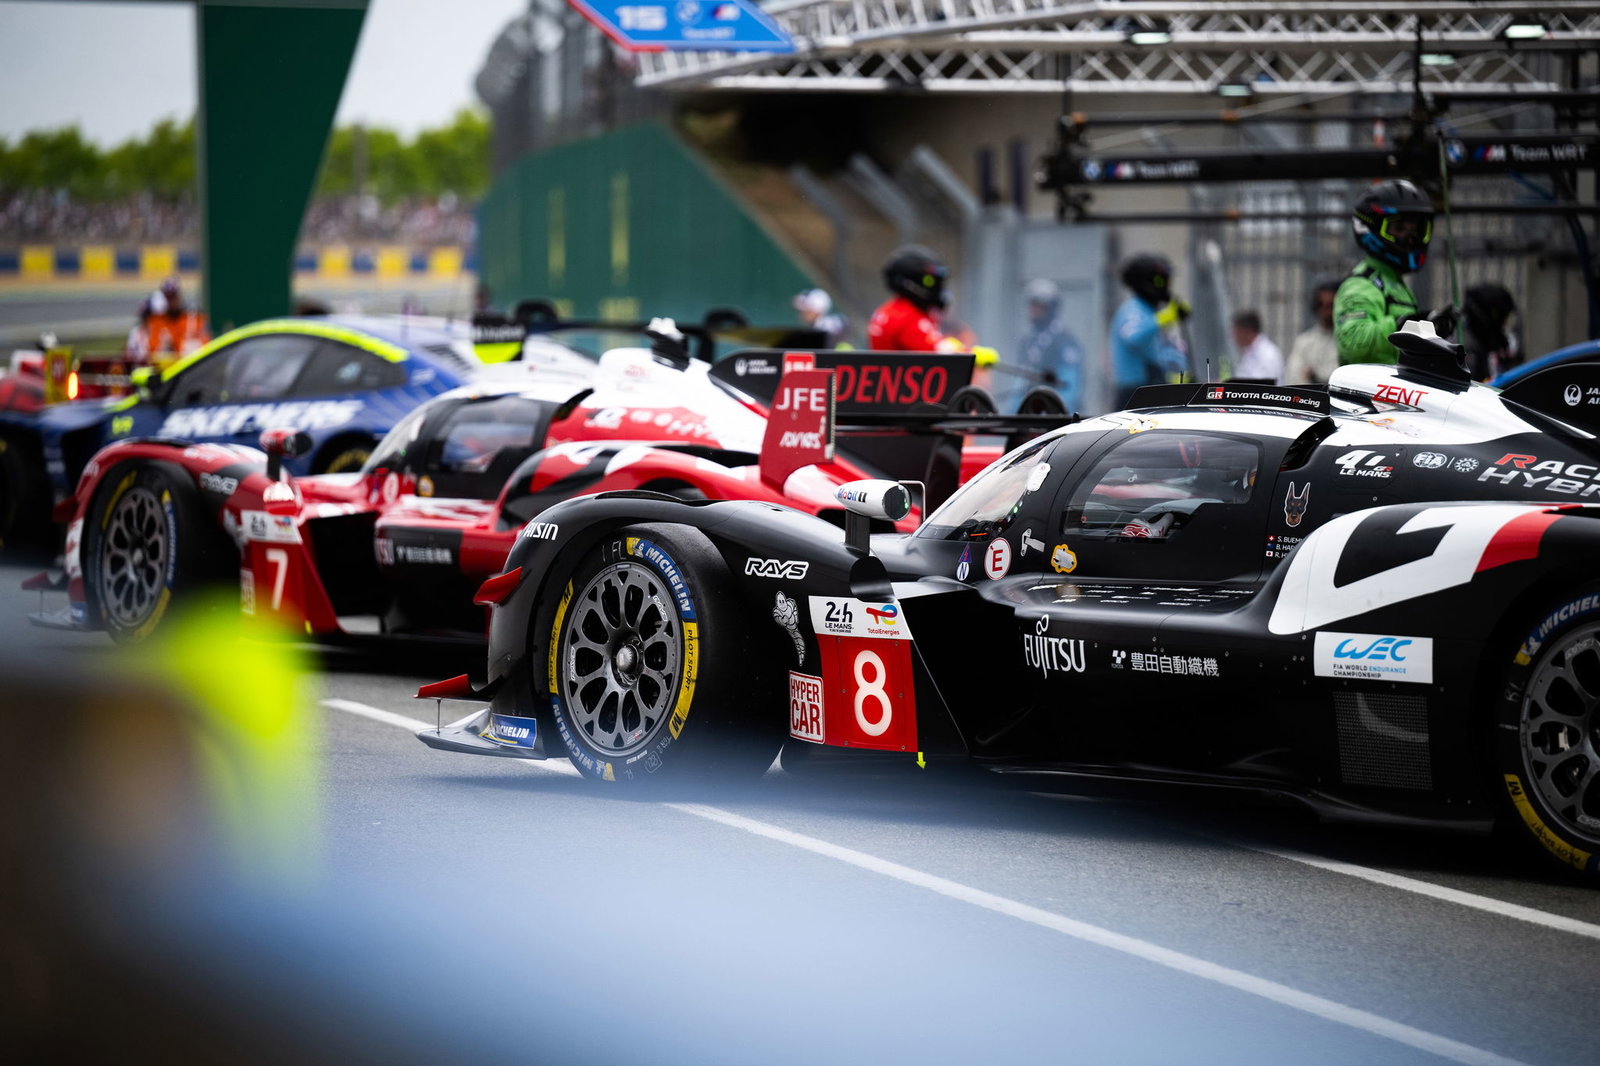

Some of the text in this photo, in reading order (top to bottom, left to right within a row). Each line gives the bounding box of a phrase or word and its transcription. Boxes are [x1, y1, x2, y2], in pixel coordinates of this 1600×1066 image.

[1510, 144, 1549, 161] Team
[1551, 144, 1588, 161] WRT
[835, 365, 948, 404] DENSO
[1373, 384, 1429, 406] ZENT
[1585, 387, 1600, 395] JA
[775, 387, 827, 412] JFE
[1292, 396, 1321, 408] Racing
[1587, 397, 1600, 405] AI
[838, 488, 858, 502] Mobil
[524, 522, 559, 541] AISIN
[744, 557, 810, 580] RAYS
[991, 549, 1004, 573] E
[265, 548, 289, 610] 7
[646, 546, 691, 612] MICHELIN
[825, 601, 853, 623] 24h
[867, 627, 900, 636] TotalEnergies
[1023, 633, 1086, 680] FUJITSU
[1333, 637, 1413, 662] WEC
[684, 659, 694, 692] SPORT
[1369, 666, 1407, 674] ENDURANCE
[790, 677, 821, 704] HYPER
[853, 649, 893, 737] 8
[790, 698, 822, 736] CAR
